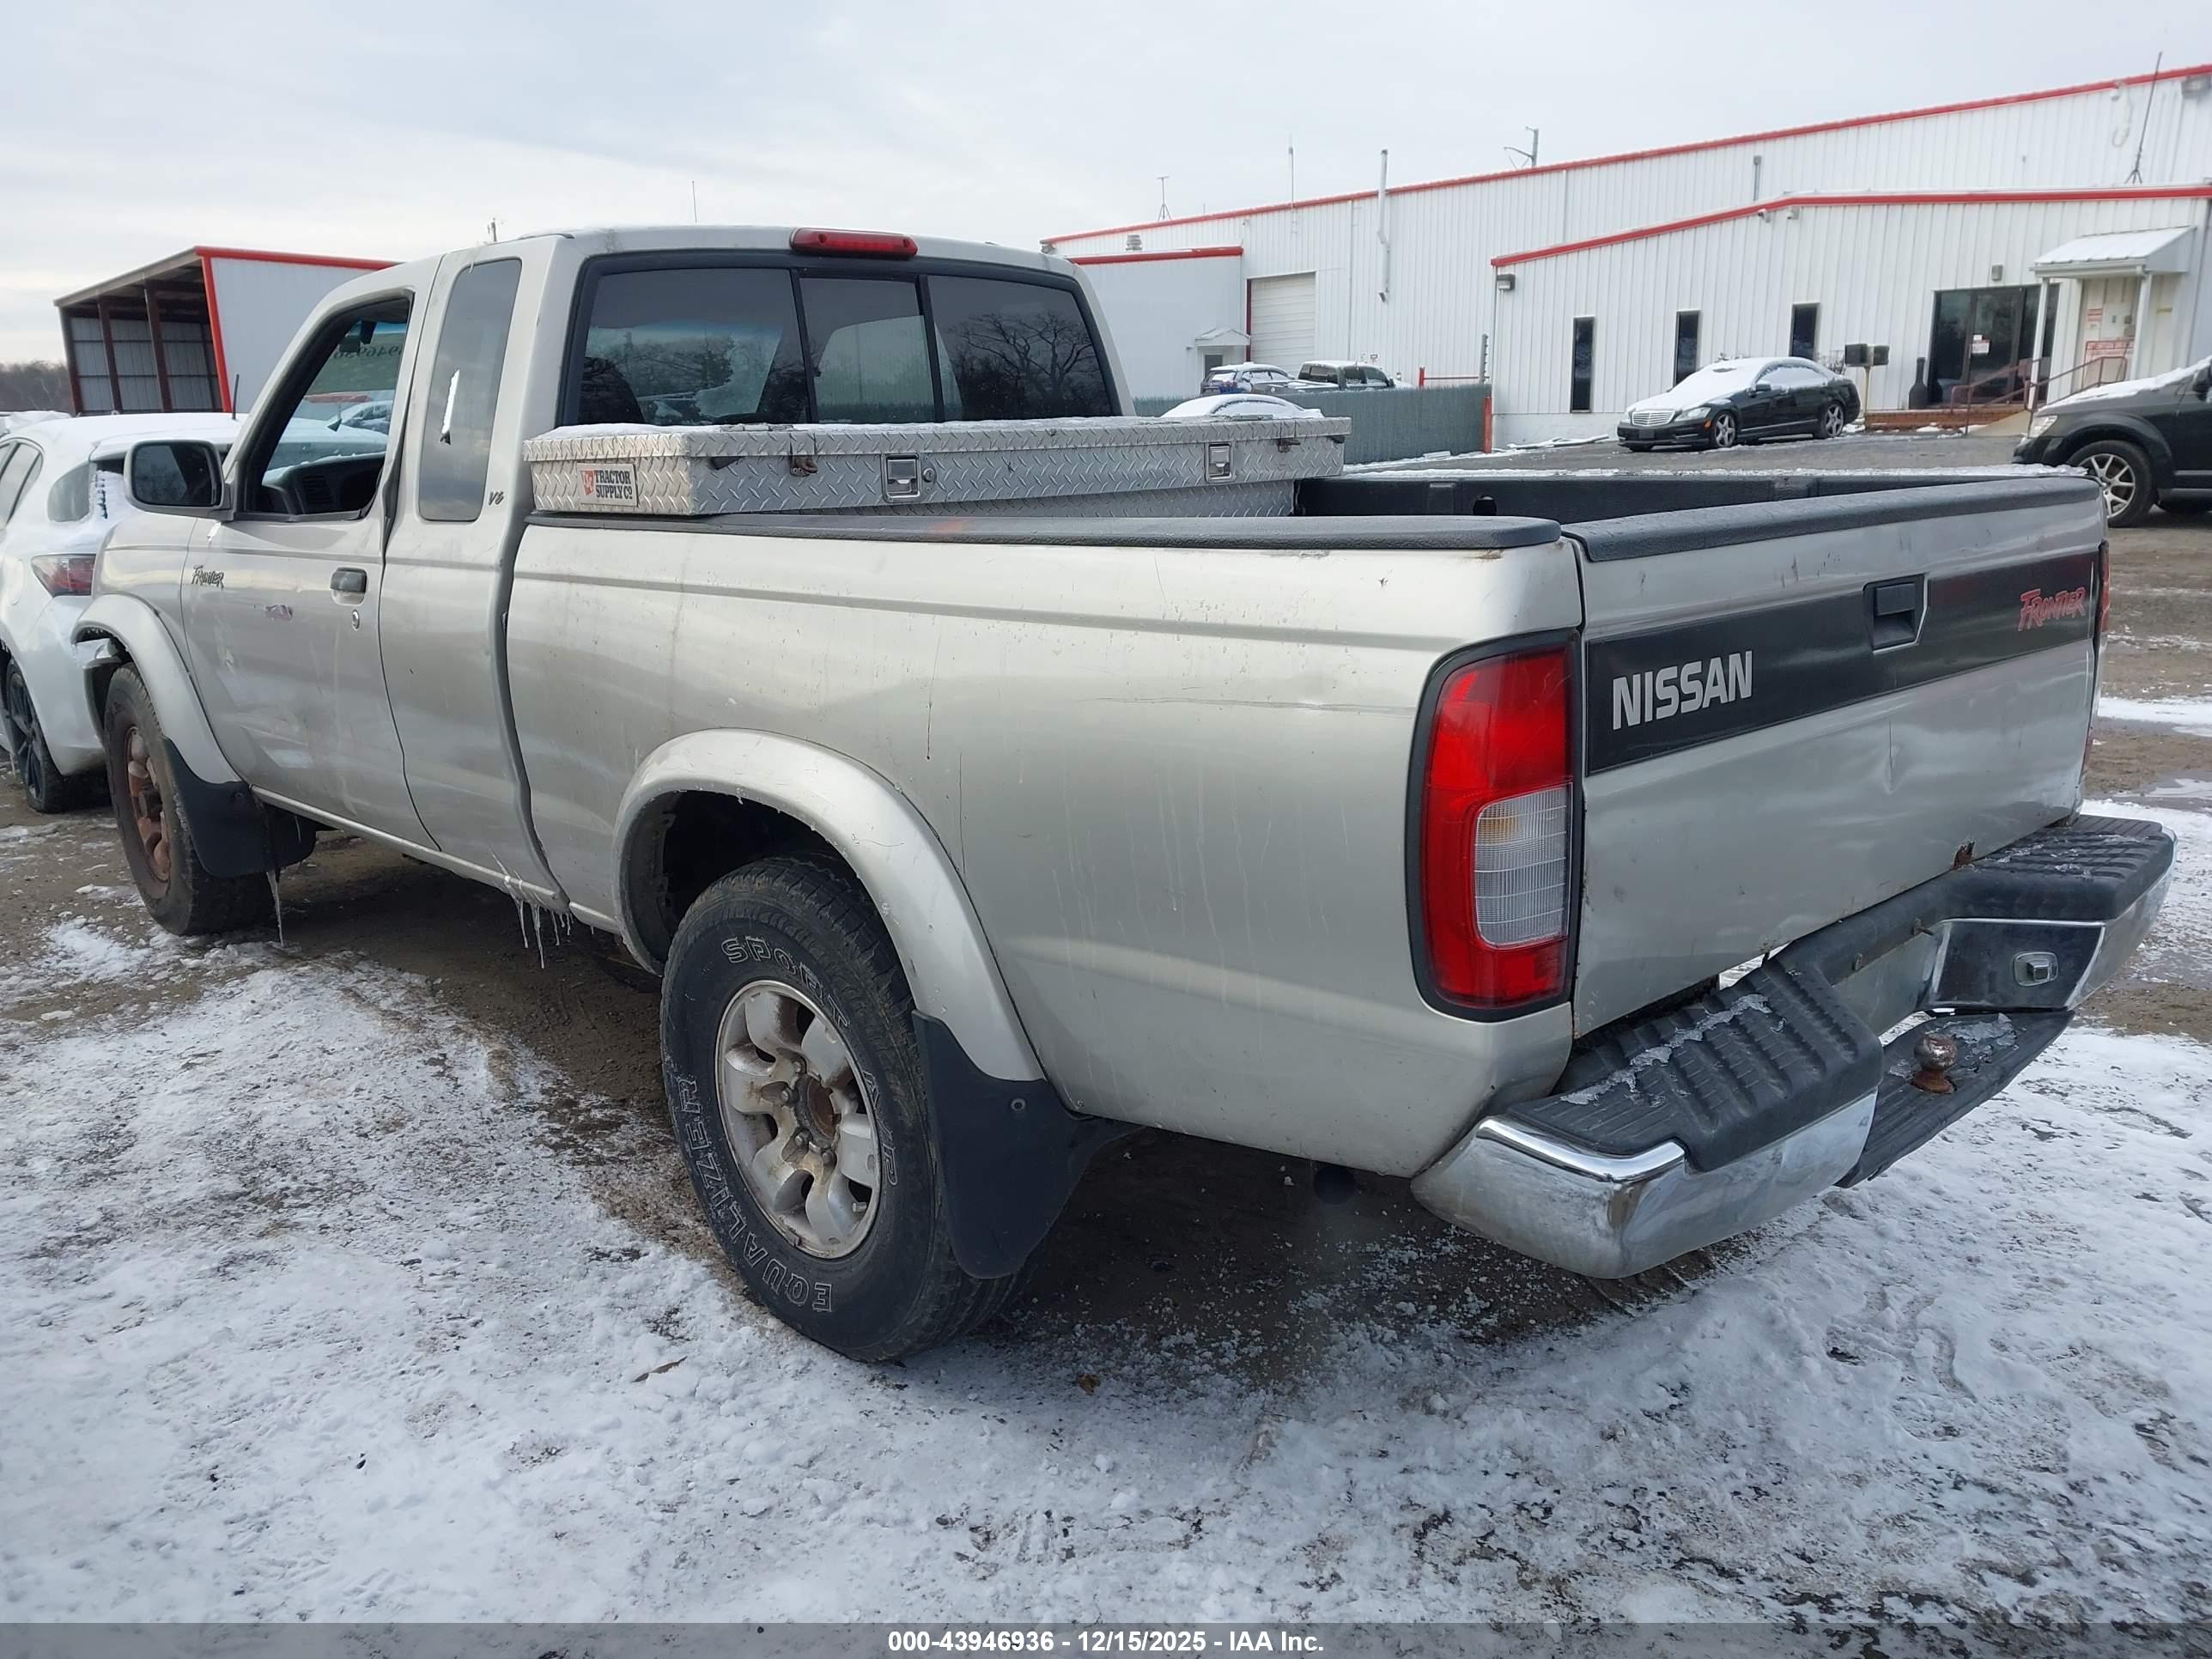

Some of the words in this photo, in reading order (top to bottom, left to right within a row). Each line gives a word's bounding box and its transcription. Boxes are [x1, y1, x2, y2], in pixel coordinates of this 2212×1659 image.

[489, 491, 504, 506] V6
[594, 470, 631, 484] TRACTOR
[596, 484, 623, 499] SUPPLY
[1613, 650, 1753, 731] NISSAN
[721, 935, 851, 1030] SPORT
[677, 1074, 833, 1312] EQUALIZER
